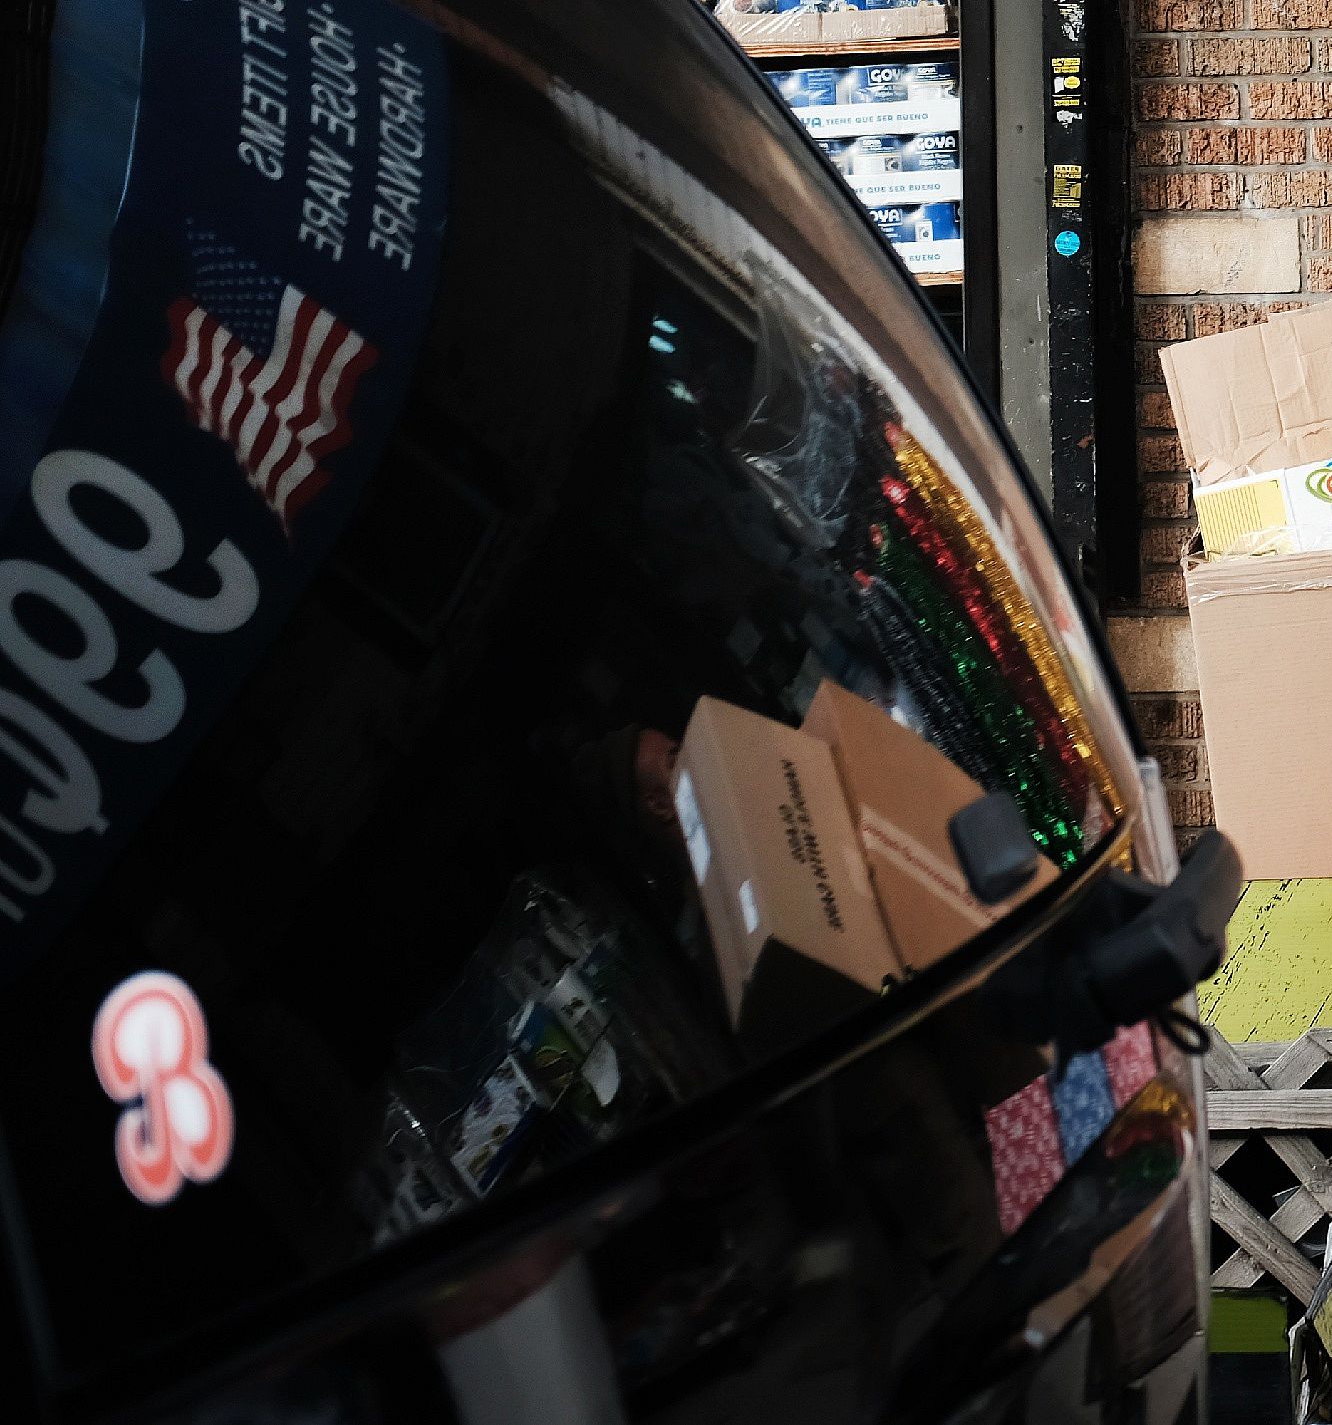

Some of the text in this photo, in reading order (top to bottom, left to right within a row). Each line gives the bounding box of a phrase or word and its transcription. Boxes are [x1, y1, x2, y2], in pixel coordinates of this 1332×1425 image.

[871, 68, 902, 83] GOY
[855, 116, 875, 125] QUE
[876, 114, 893, 123] SER
[896, 112, 929, 122] BUENO
[916, 135, 956, 151] GOYA
[908, 182, 941, 192] BUENO
[909, 253, 941, 262] BUENO
